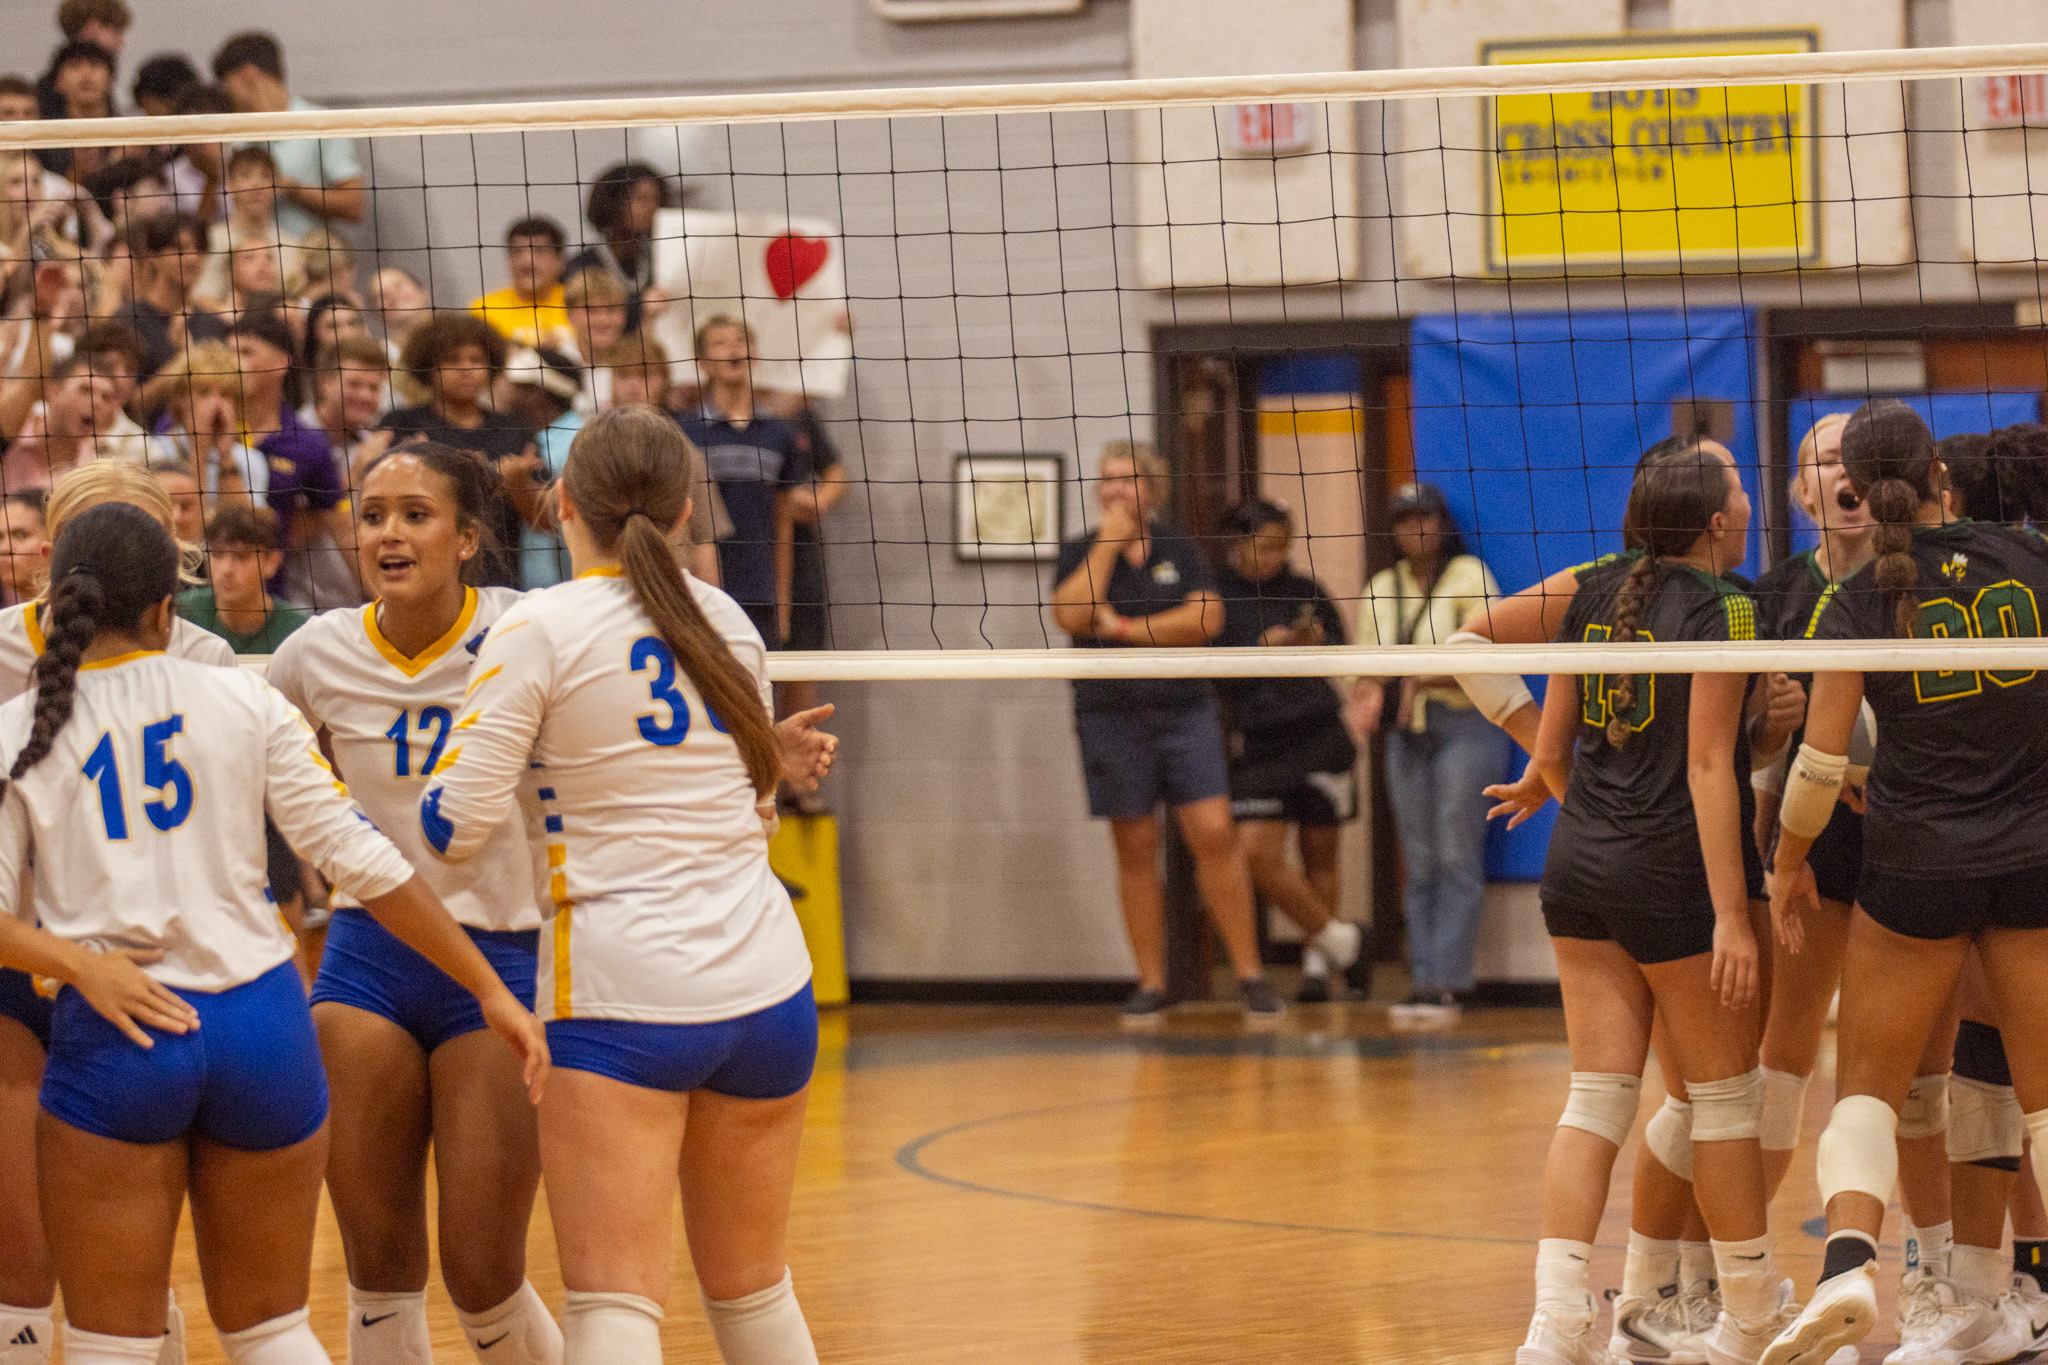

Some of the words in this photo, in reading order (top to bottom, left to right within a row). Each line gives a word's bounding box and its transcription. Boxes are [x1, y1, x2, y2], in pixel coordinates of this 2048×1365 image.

[1500, 118, 1611, 161] CROSS
[1629, 112, 1799, 157] COUNTRY
[628, 632, 735, 747] 3
[81, 710, 198, 842] 15
[383, 702, 456, 778] 12
